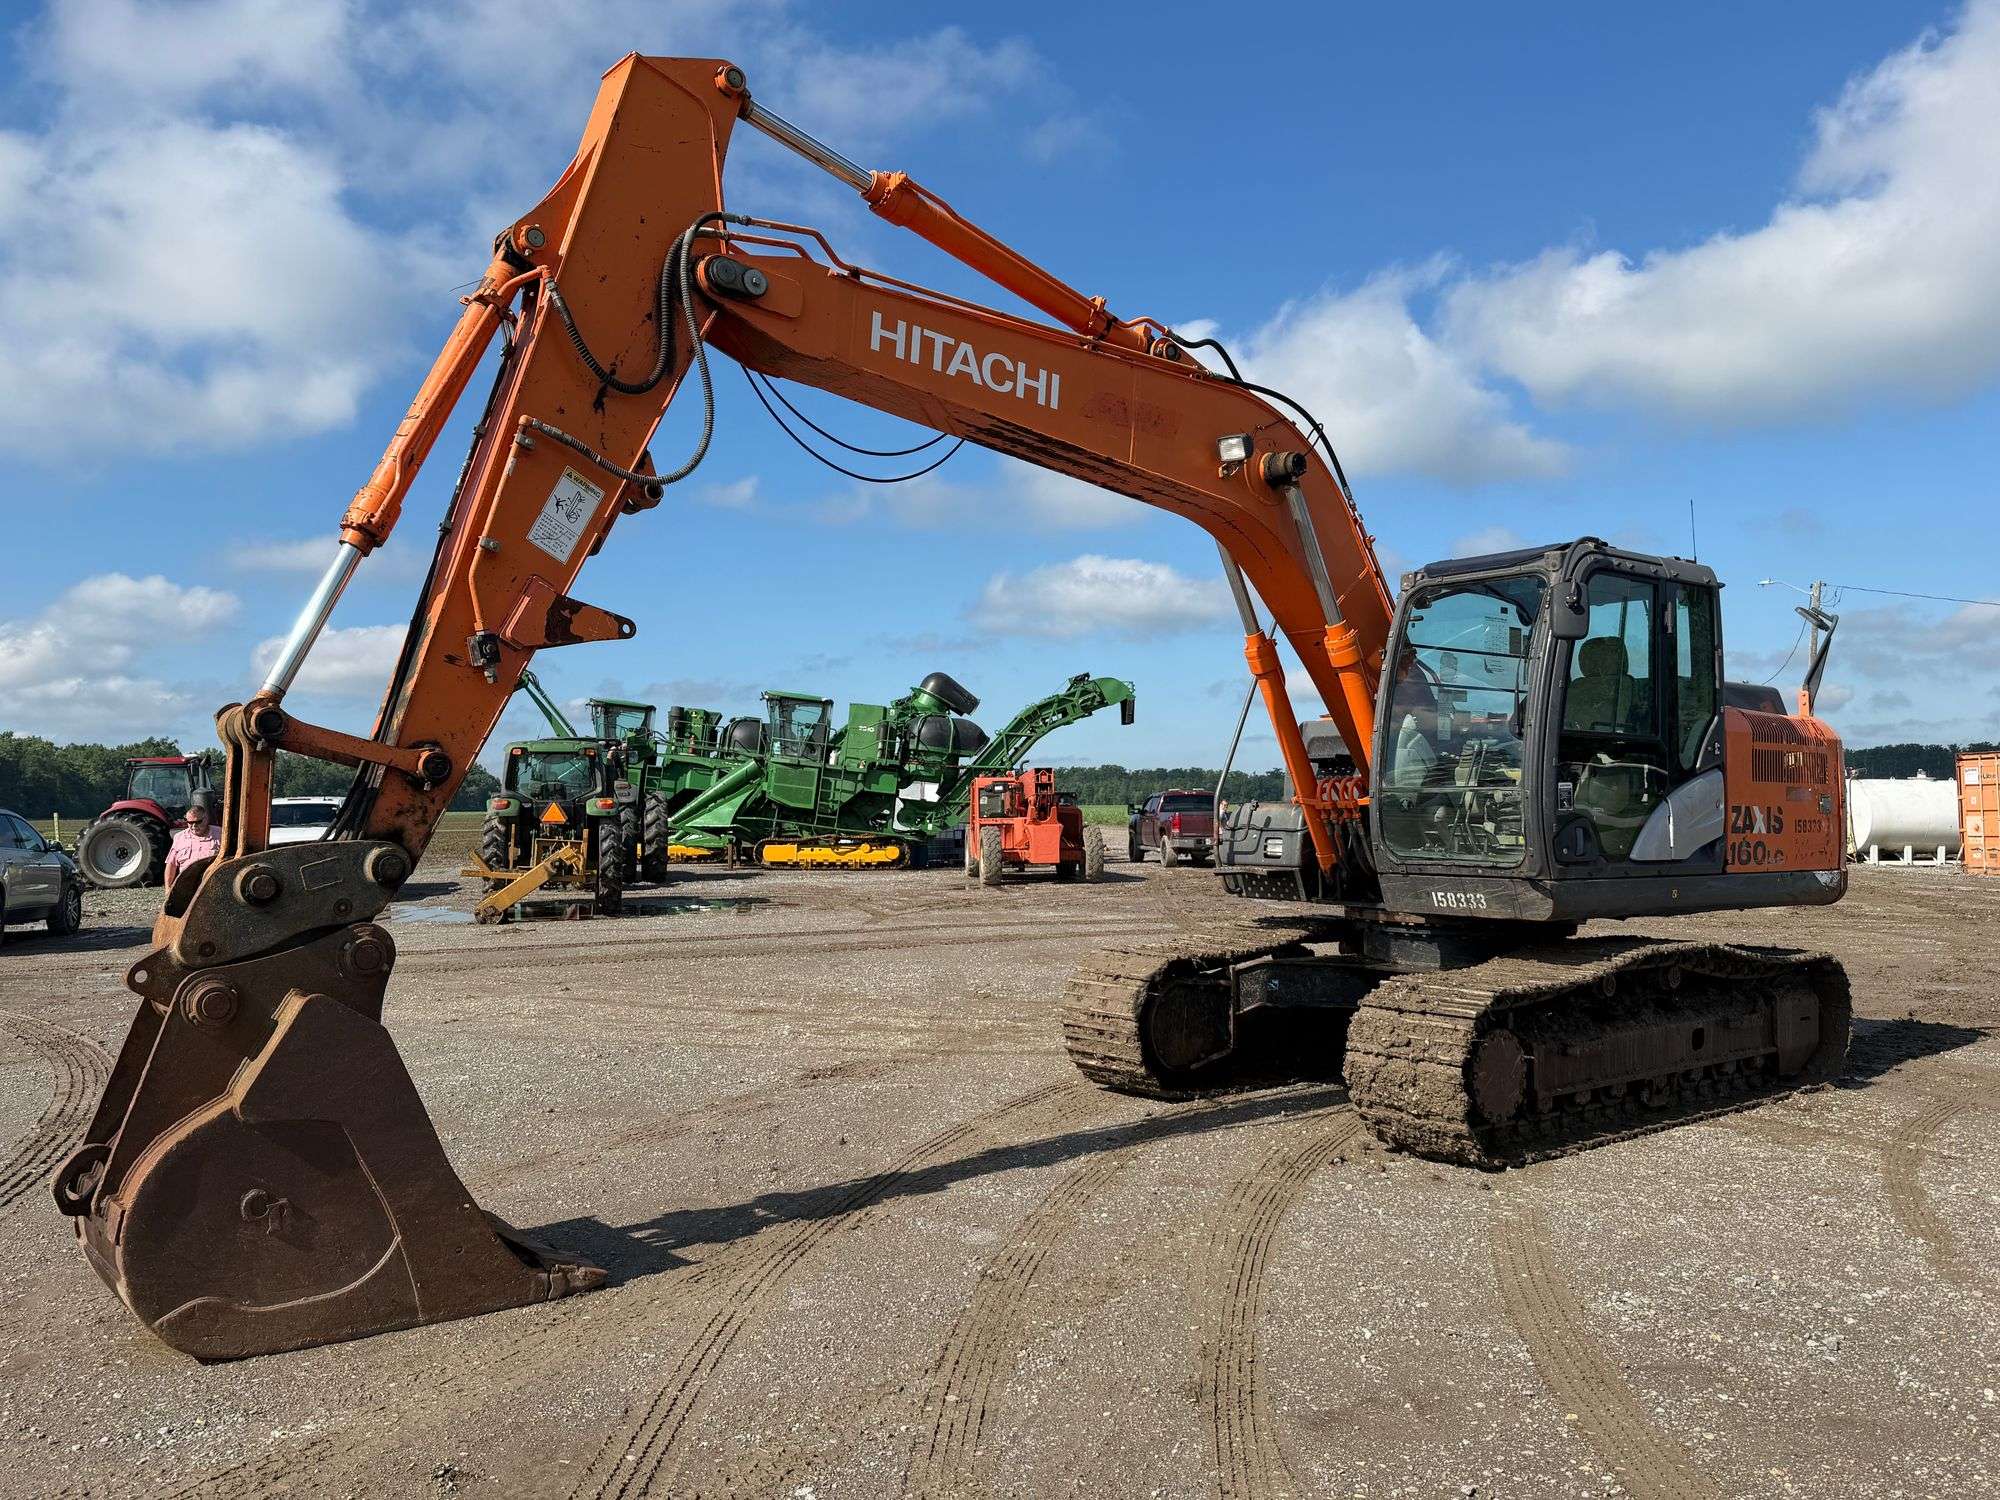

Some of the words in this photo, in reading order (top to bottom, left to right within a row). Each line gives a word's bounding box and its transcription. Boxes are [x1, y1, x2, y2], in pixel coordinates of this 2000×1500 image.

[870, 310, 1060, 410] HITACHI
[573, 474, 602, 499] WARNING
[1731, 805, 1784, 835] ZAXIS
[1431, 891, 1487, 909] 158333
